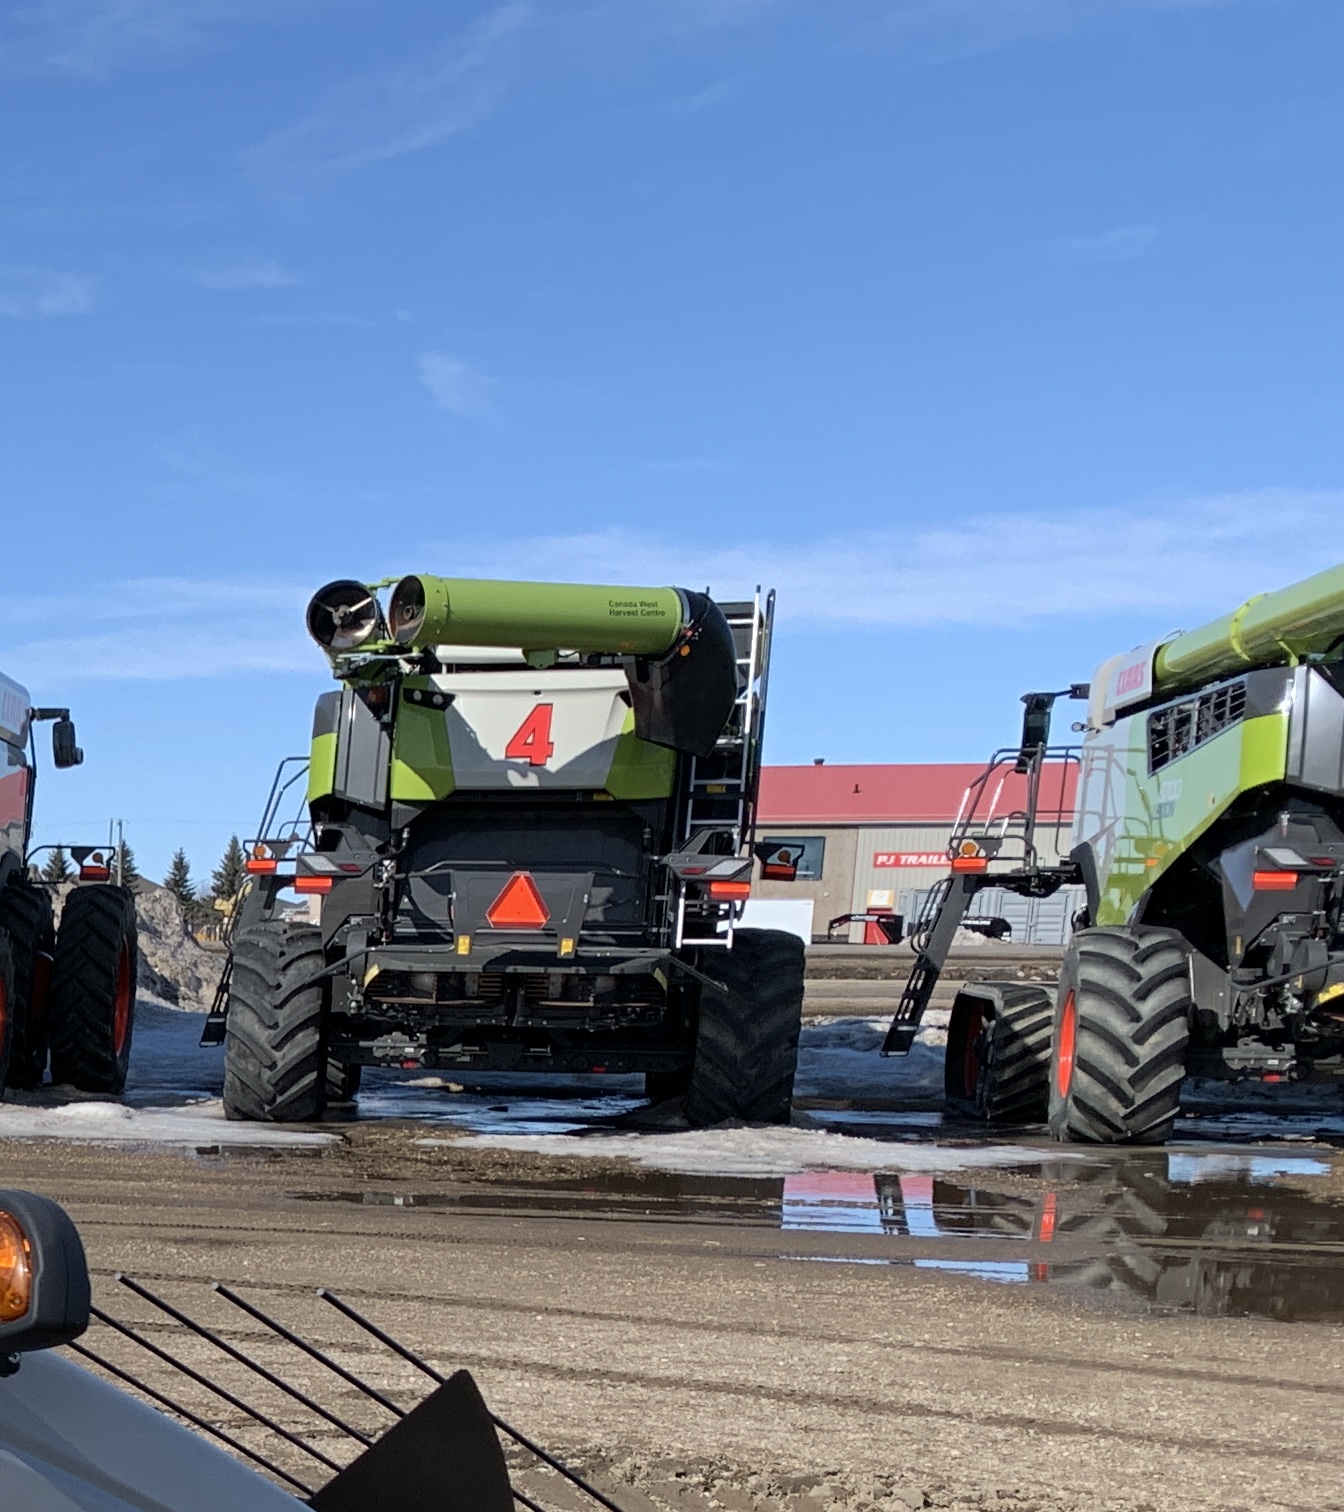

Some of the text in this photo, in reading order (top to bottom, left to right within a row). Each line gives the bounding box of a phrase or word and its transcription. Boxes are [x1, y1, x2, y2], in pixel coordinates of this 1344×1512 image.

[608, 600, 637, 608] Canada
[505, 703, 554, 767] 4
[876, 855, 896, 865] PJ
